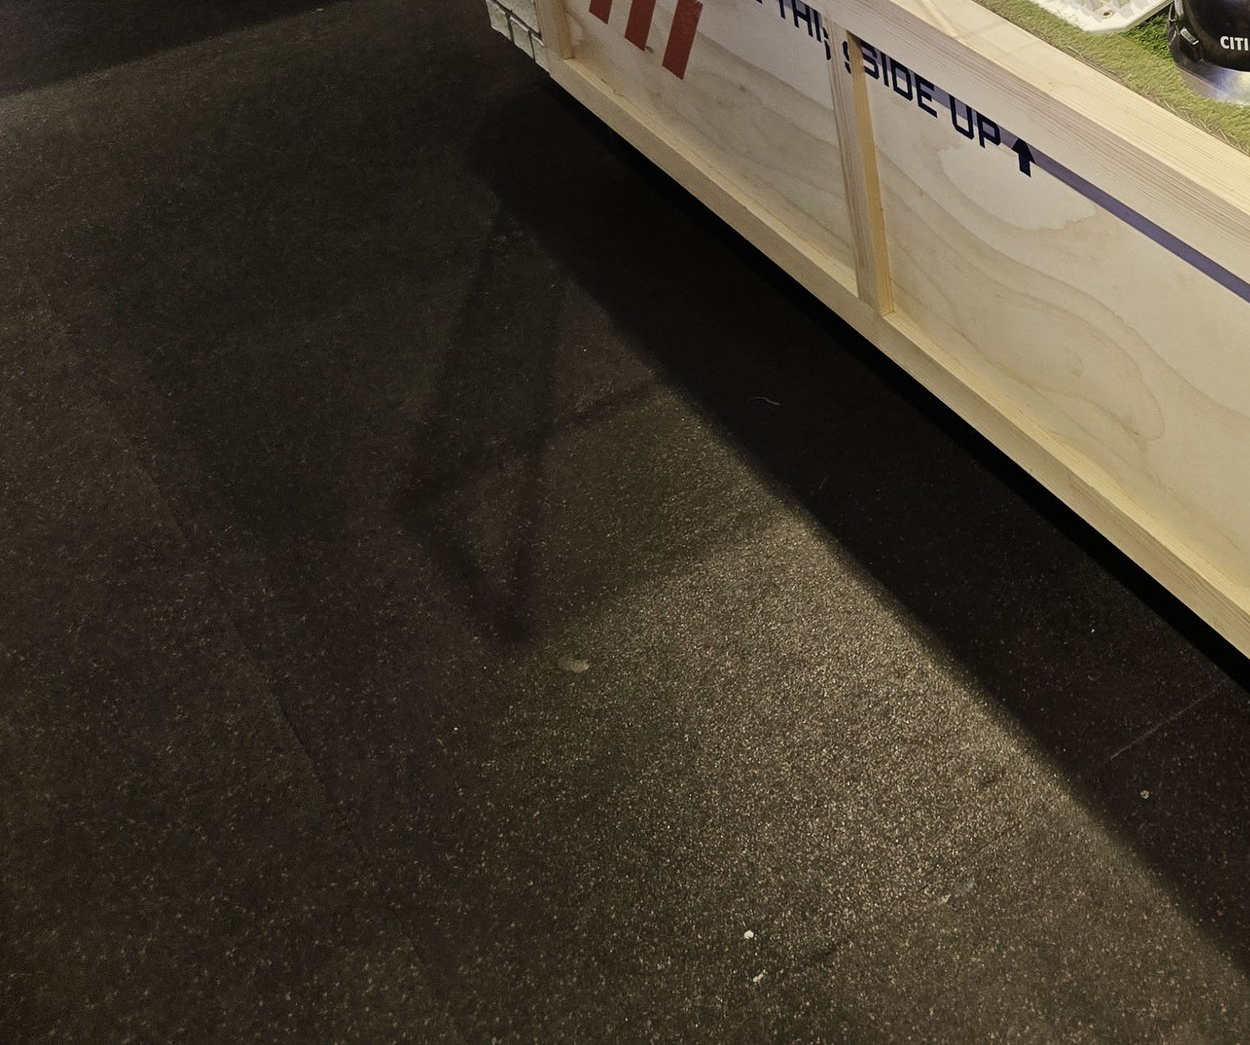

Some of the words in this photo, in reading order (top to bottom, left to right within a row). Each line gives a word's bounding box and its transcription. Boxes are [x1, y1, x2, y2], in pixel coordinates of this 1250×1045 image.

[1220, 35, 1249, 51] CITI
[842, 36, 938, 118] SIDE
[949, 93, 1001, 149] UP
